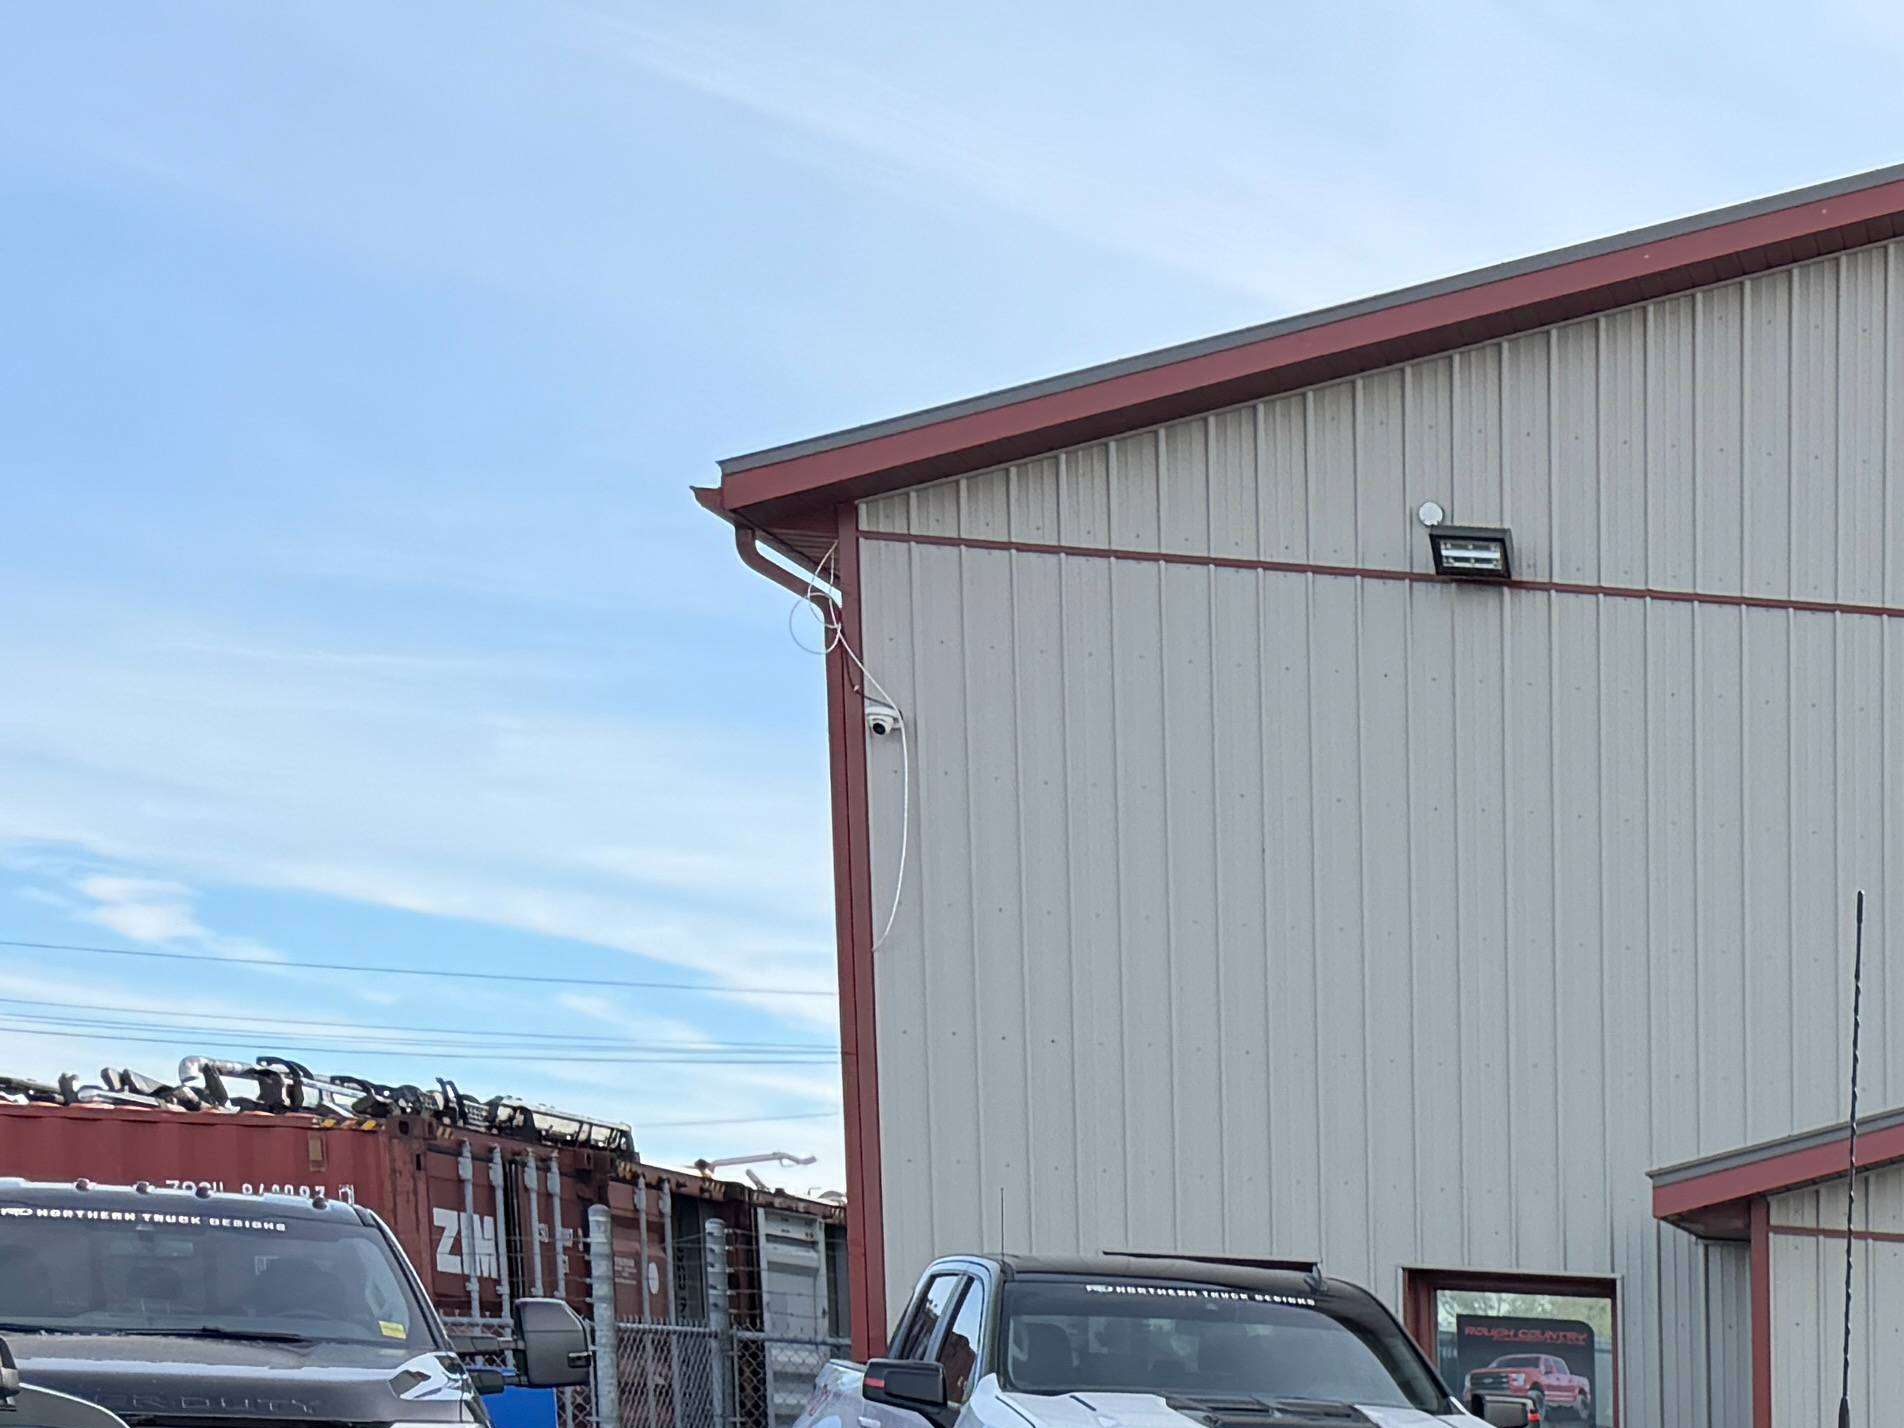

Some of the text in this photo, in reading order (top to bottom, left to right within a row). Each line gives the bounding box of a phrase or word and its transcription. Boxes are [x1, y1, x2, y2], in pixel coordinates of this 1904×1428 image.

[36, 1208, 136, 1221] NORTHERN
[141, 1212, 201, 1225] TRUCK
[432, 1206, 499, 1280] ZIM
